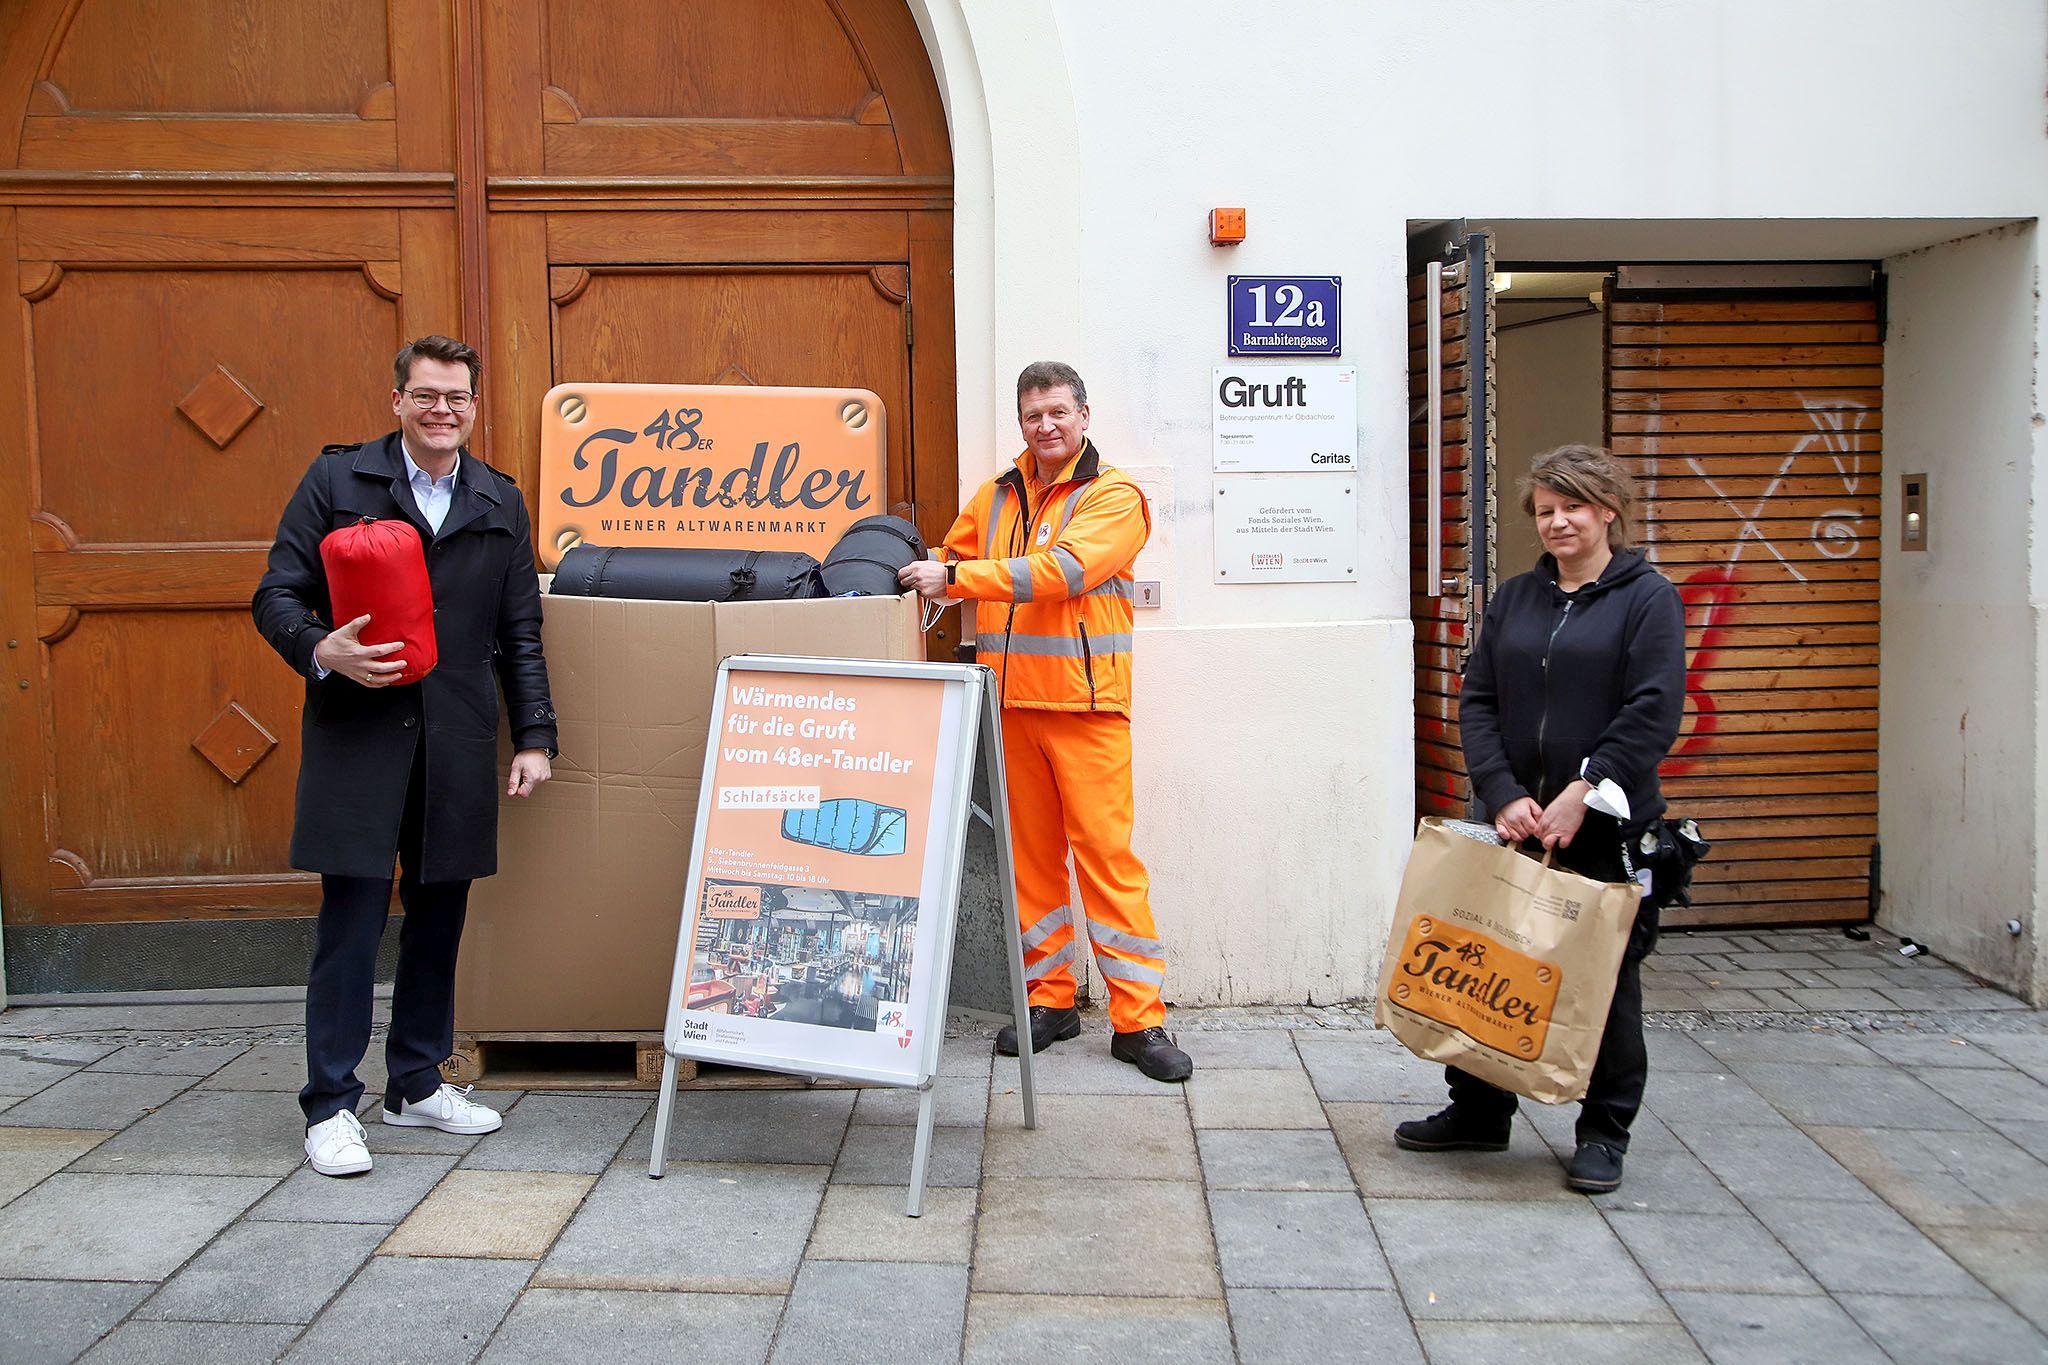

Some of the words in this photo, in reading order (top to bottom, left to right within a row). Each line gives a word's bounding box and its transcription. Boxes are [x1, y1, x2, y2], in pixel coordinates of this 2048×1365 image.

[1248, 284, 1326, 327] 12a
[1242, 332, 1329, 348] Barnabitengasse
[1219, 376, 1307, 408] Gruft
[1219, 414, 1283, 422] Betreuungszentrum
[1285, 413, 1294, 421] für
[1296, 413, 1335, 421] Obdachlose
[1311, 452, 1350, 464] Caritas
[560, 428, 872, 511] Tandler
[601, 519, 667, 532] WIENER
[676, 520, 826, 533] ALTWARENMARKT
[1251, 526, 1278, 534] Mitteln
[732, 686, 856, 711] Wärmendes
[727, 713, 758, 734] für
[762, 715, 795, 737] die
[799, 718, 857, 740] Gruft
[723, 746, 768, 764] vom
[772, 746, 913, 774] 48er-Tandler
[723, 790, 816, 803] Schlafsäcke
[709, 847, 755, 858] 48er-Tandler
[718, 858, 804, 873] Siebenbrunnenfeldgasse
[706, 866, 740, 876] Mittwoch
[741, 869, 752, 877] bis
[752, 870, 785, 882] Samstag:
[786, 873, 794, 881] 10
[795, 874, 806, 882] bis
[808, 875, 816, 883] 18
[817, 876, 830, 884] Uhr
[709, 893, 758, 909] Tandler
[1452, 908, 1484, 925] SOZIAL
[1403, 940, 1539, 1026] Tandler
[1419, 985, 1452, 1004] WIENER
[684, 1019, 709, 1031] Stadt
[683, 1030, 707, 1041] Wien
